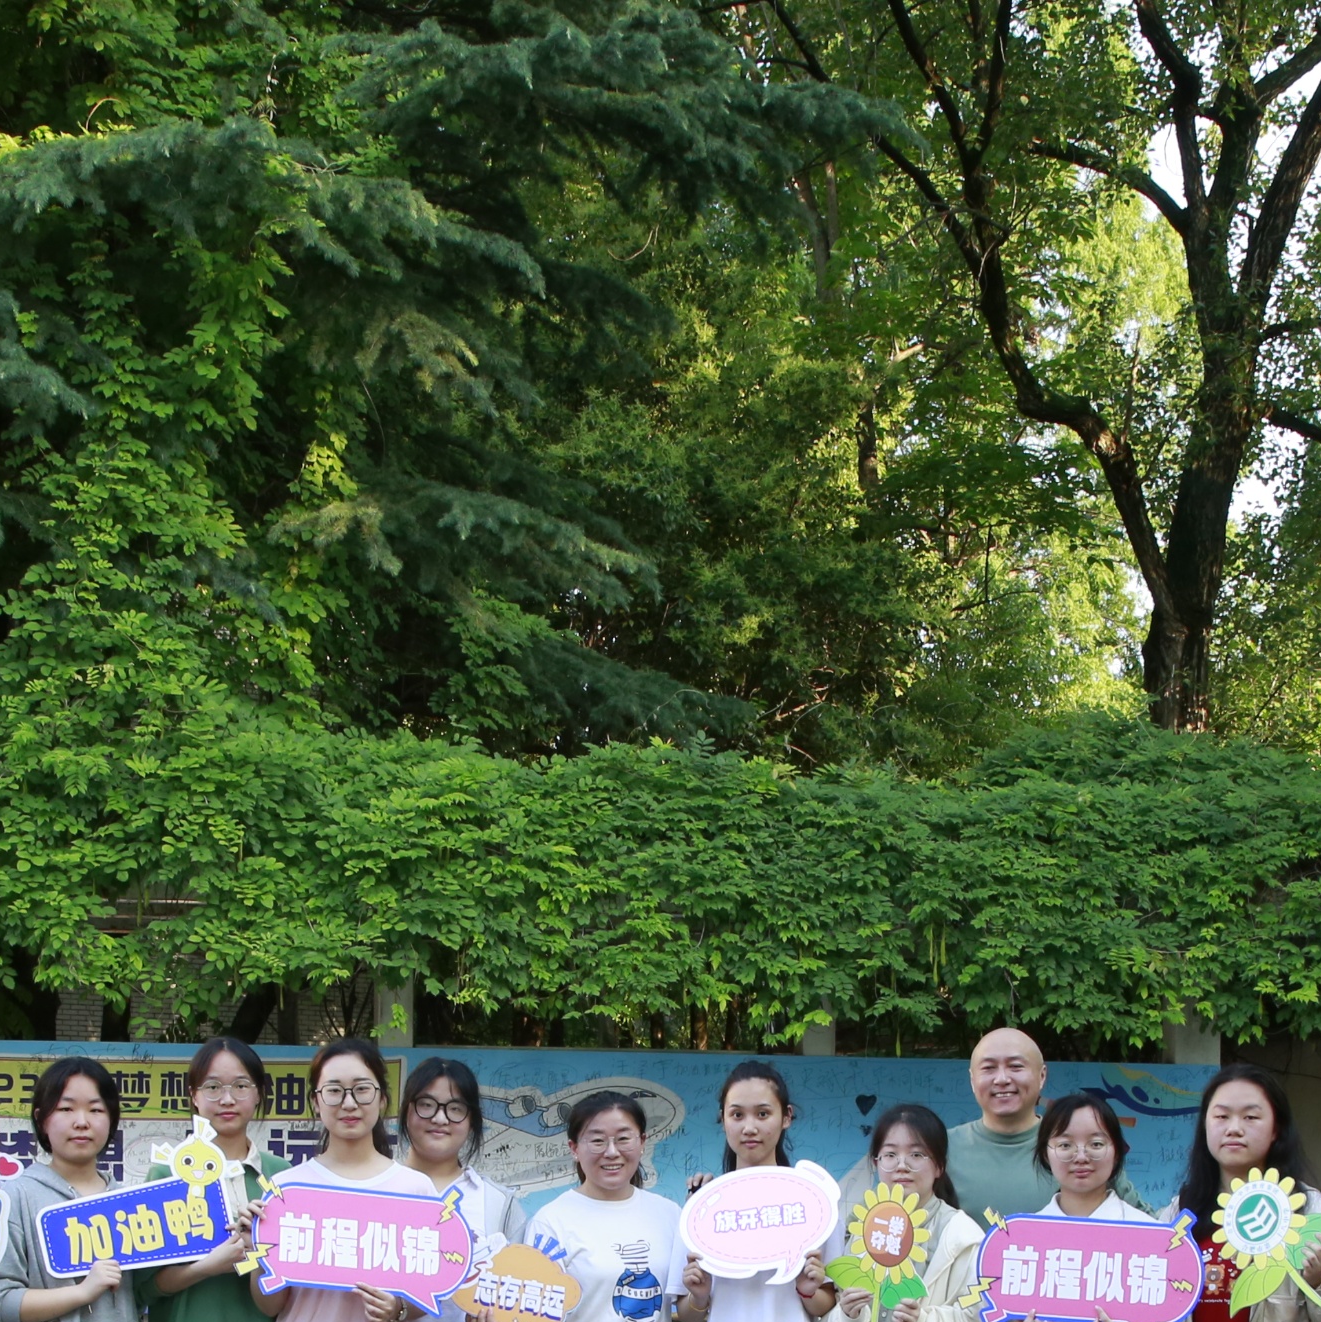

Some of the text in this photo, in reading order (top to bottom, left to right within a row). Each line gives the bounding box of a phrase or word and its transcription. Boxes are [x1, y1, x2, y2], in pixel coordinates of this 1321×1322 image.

[64, 1197, 214, 1265] 加油鸭
[714, 1202, 806, 1233] 旗开得胜
[870, 1230, 902, 1256] 夺魁
[873, 1216, 905, 1236] 一举
[278, 1212, 441, 1276] 前程似锦
[473, 1269, 566, 1321] 志存高远
[1000, 1244, 1169, 1306] 前程似锦
